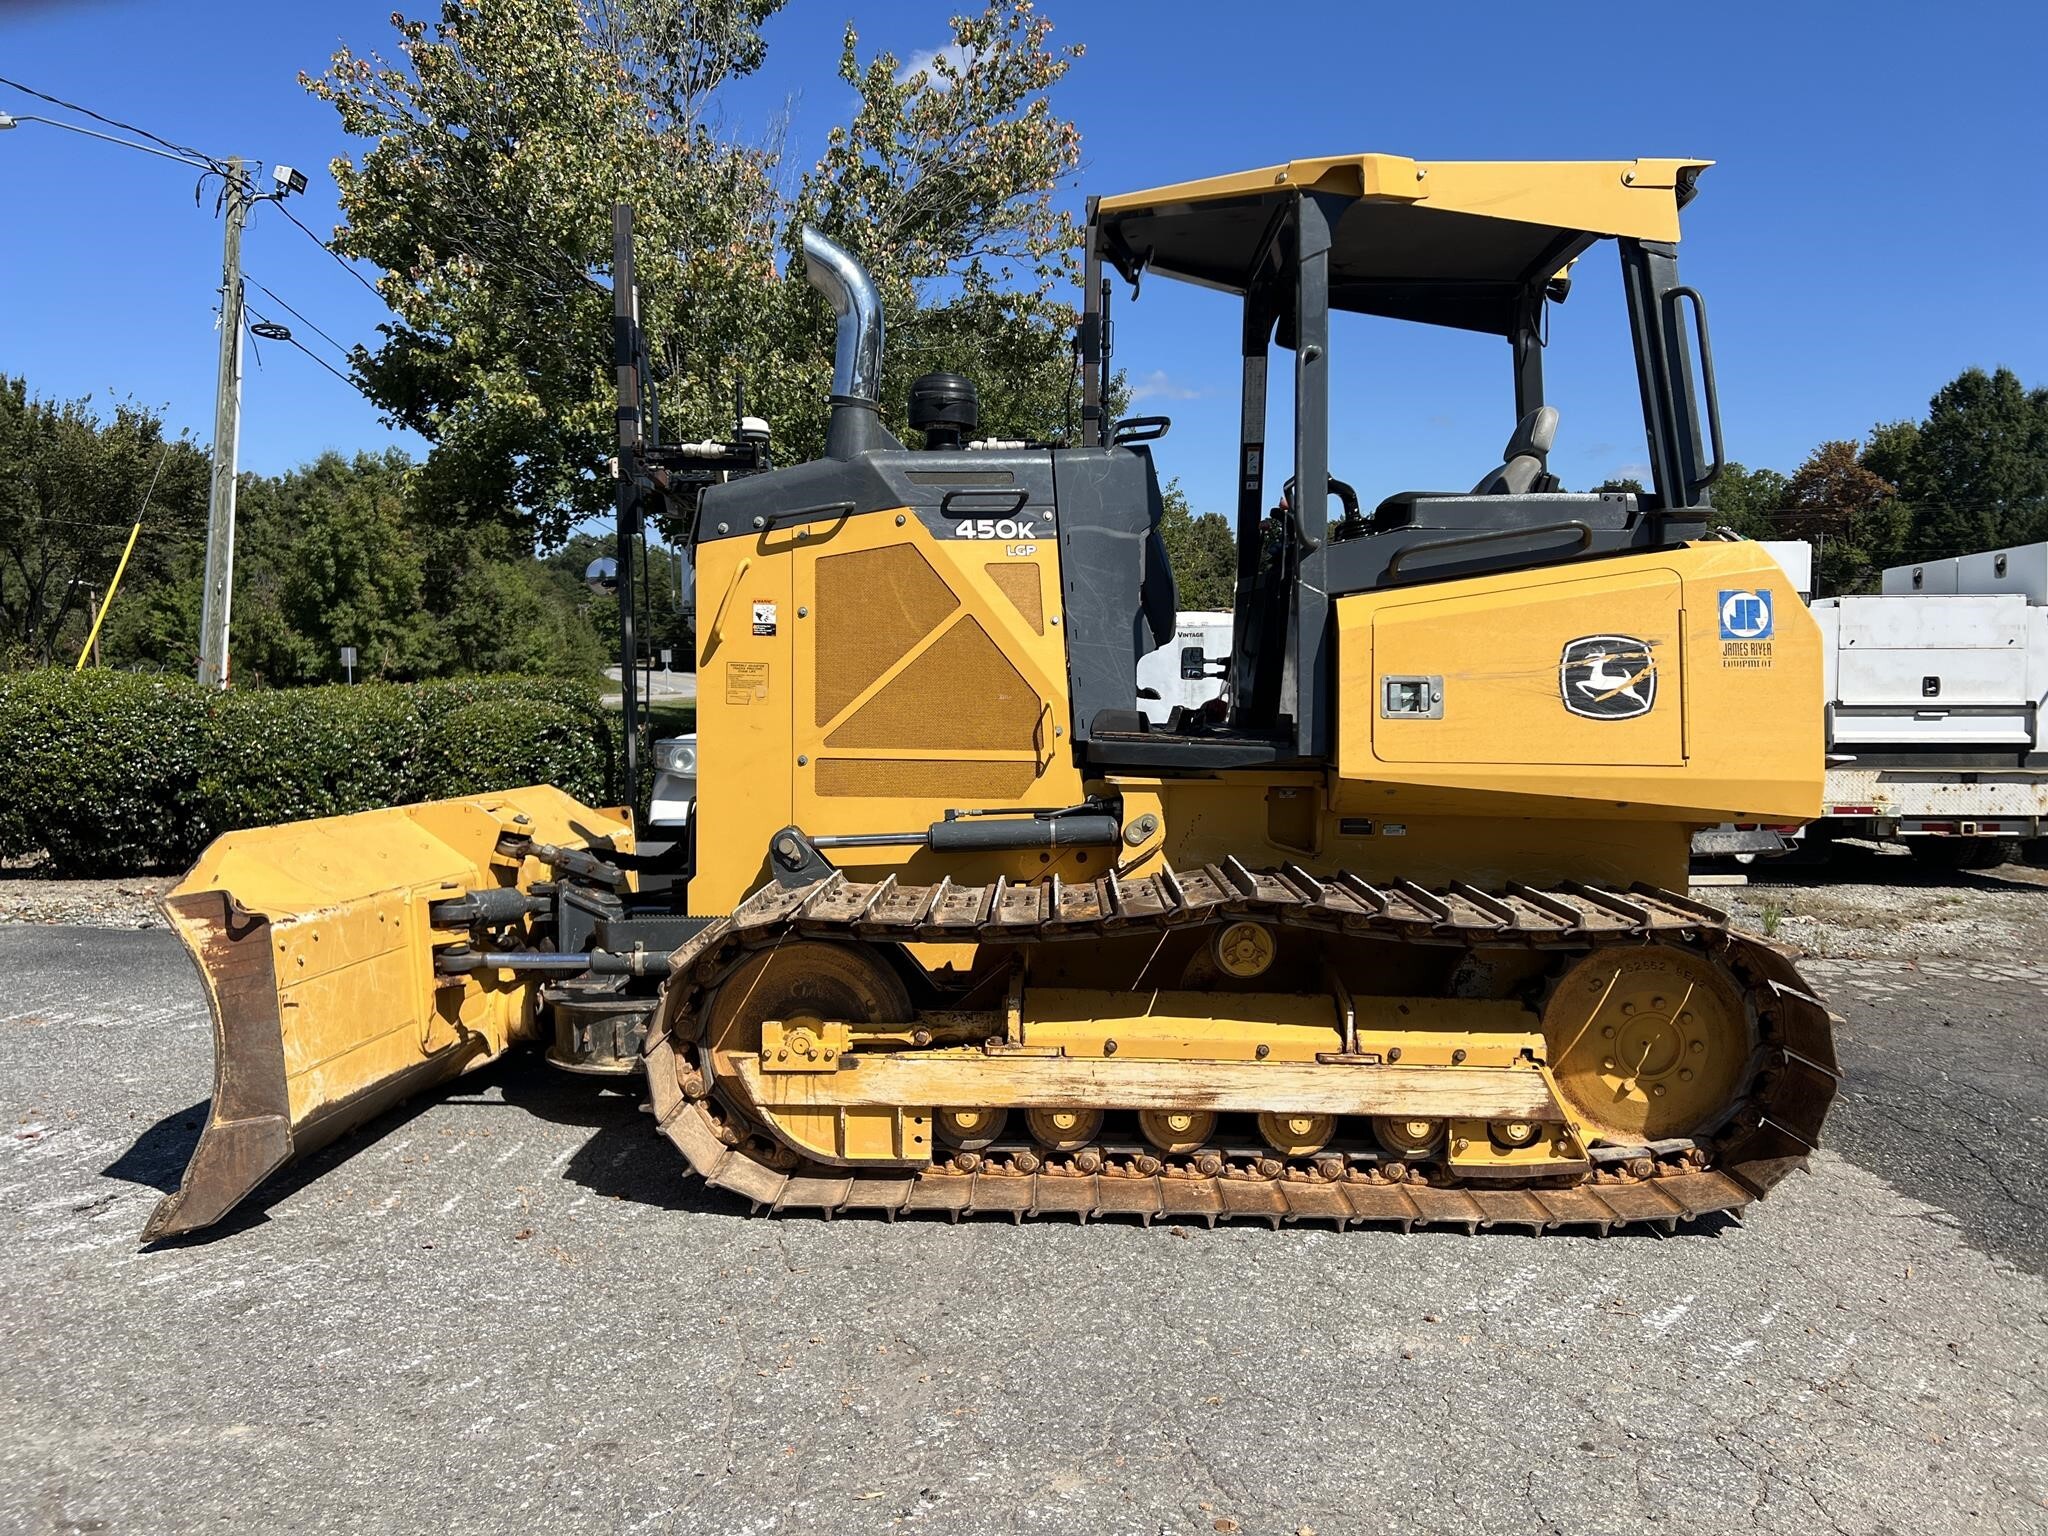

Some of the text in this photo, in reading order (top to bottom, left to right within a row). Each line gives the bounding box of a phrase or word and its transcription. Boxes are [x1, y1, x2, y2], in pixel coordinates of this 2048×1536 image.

[955, 519, 1036, 539] 450K
[1006, 545, 1037, 557] LGP
[1722, 642, 1772, 657] JAMES RIVER
